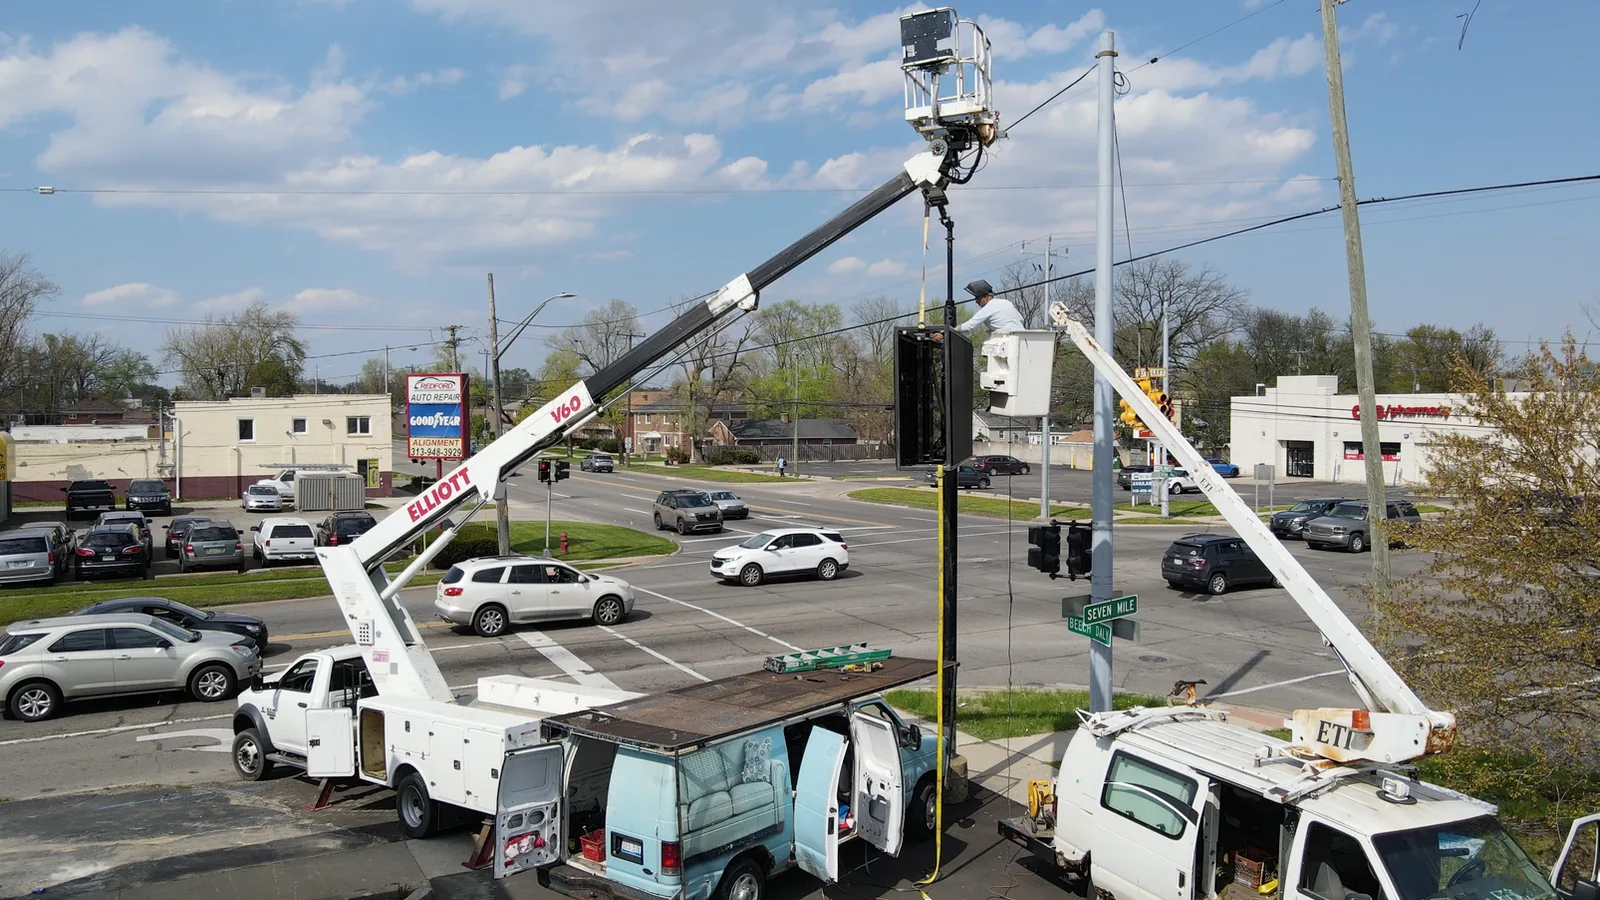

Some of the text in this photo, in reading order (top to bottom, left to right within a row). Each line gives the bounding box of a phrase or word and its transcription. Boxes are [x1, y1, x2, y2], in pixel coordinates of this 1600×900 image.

[419, 382, 454, 390] REDFORD
[411, 393, 460, 401] AUTO REPAIR
[550, 395, 582, 424] V60
[410, 412, 460, 428] GOODYEAR
[410, 447, 462, 457] 313-948-3929
[412, 439, 460, 447] ALIGNMENT
[407, 466, 472, 523] ELLIOTT
[1087, 599, 1135, 621] SEVEN MILE
[1069, 617, 1110, 641] BEECH DALY
[1316, 720, 1353, 750] ETI
